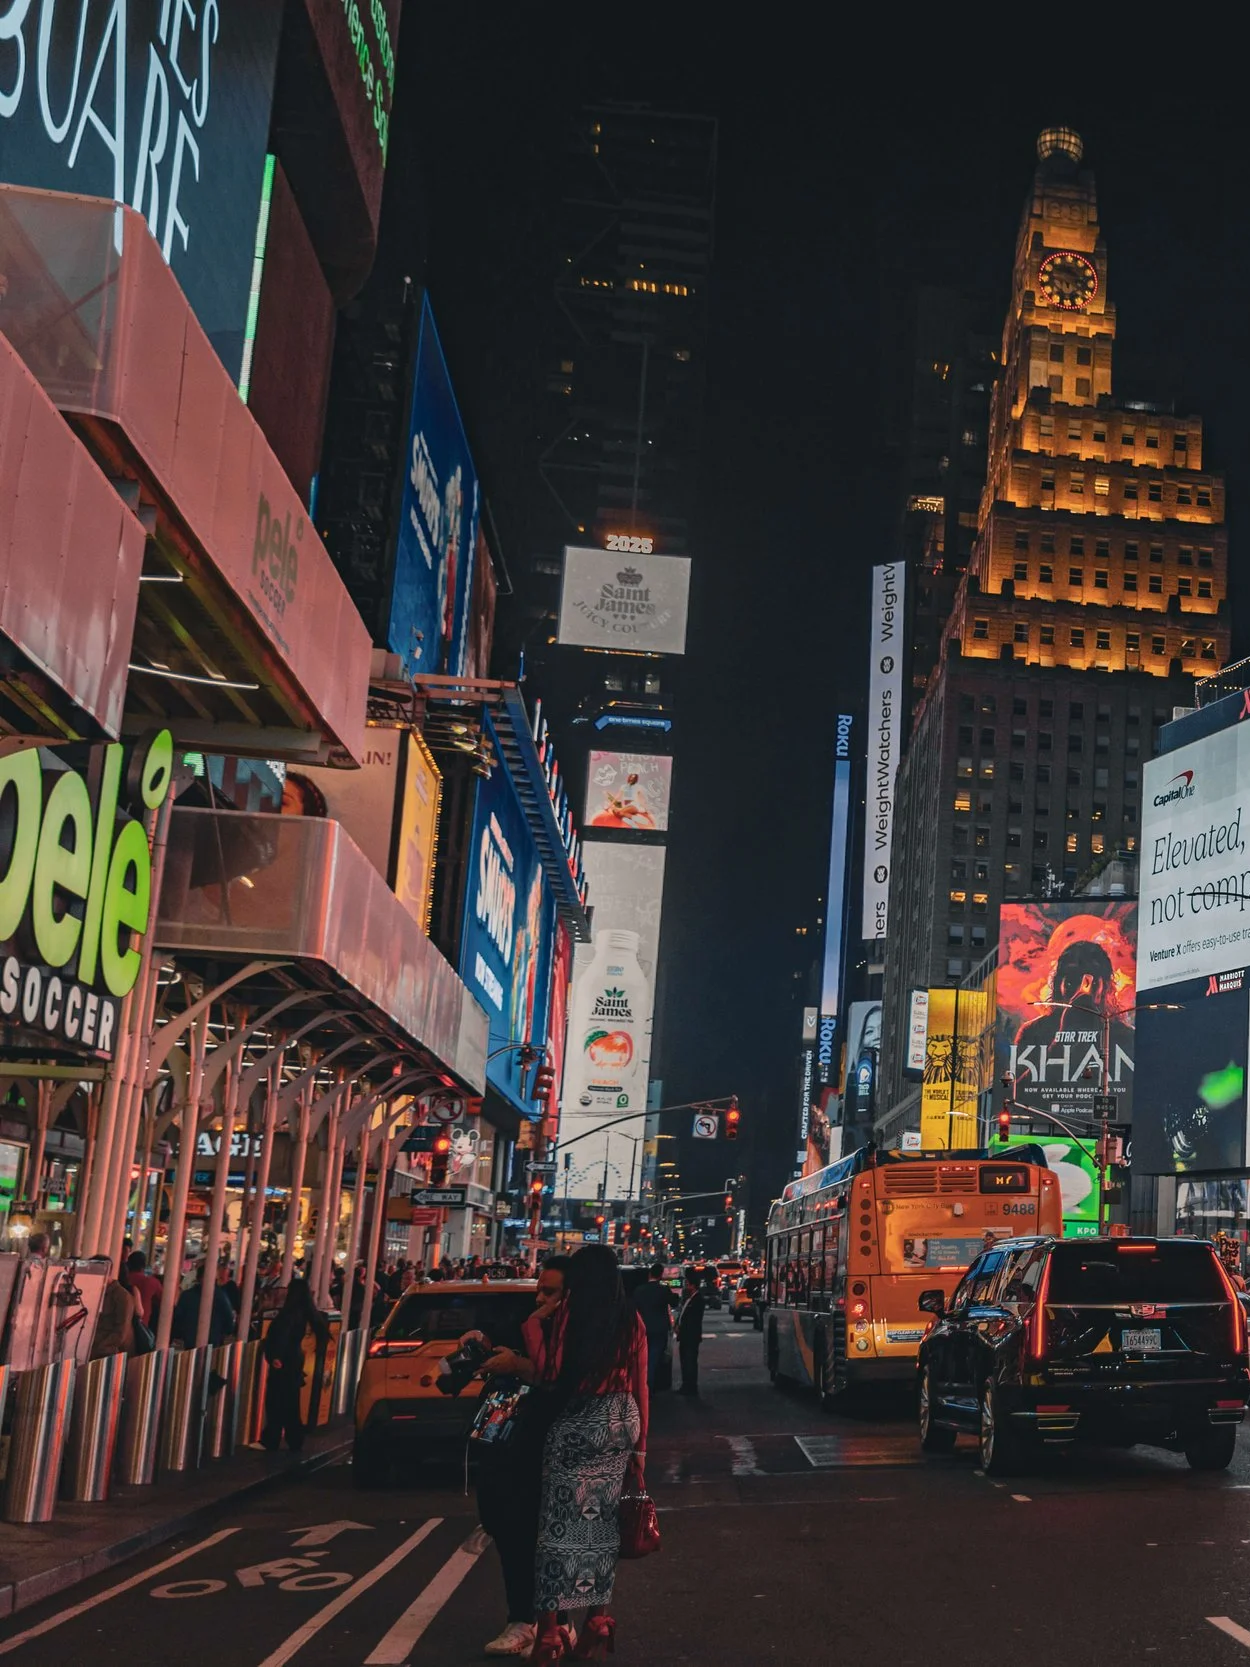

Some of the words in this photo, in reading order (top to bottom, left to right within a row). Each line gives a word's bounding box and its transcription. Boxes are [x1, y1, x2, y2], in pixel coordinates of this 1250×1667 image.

[606, 534, 654, 554] 2025
[601, 583, 651, 602] Saint
[594, 598, 656, 615] James
[642, 719, 665, 727] square
[874, 689, 894, 851] WeightWatchers
[1151, 807, 1246, 876] Elevated,
[1150, 886, 1185, 926] not
[1149, 944, 1175, 963] Venture
[1176, 943, 1182, 956] X
[1183, 939, 1201, 955] offers
[1202, 931, 1241, 950] easy-to-use
[1219, 969, 1245, 981] MARRIOTT
[1219, 979, 1242, 991] MARQUIS
[0, 956, 115, 1051] SOCCER
[595, 996, 629, 1008] Saint
[591, 1006, 632, 1017] James
[1055, 1031, 1076, 1043] STAR
[1077, 1031, 1099, 1043] TREK
[1002, 1203, 1035, 1215] 9488
